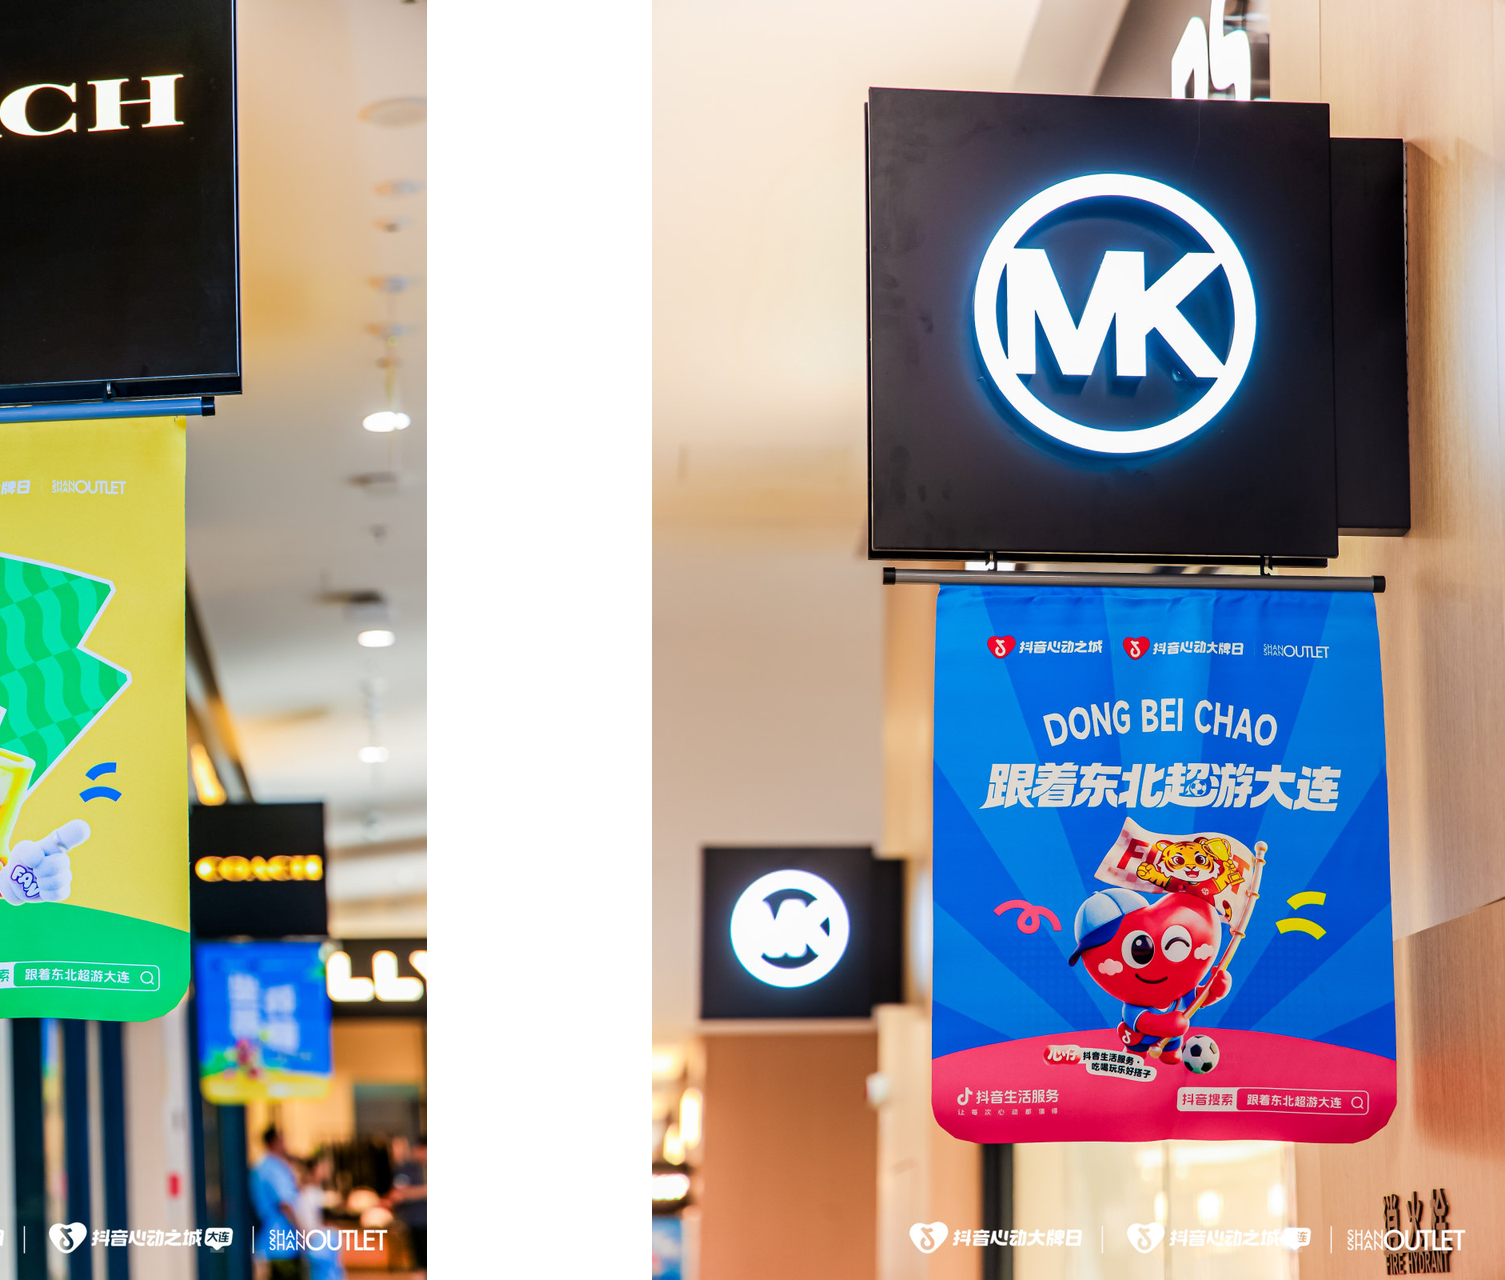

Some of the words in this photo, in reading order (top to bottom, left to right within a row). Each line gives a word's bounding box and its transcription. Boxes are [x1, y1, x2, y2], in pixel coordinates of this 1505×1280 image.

[1007, 248, 1226, 378] MK
[75, 480, 126, 495] OUTLET
[1019, 640, 1103, 654] 抖音心动之城
[1153, 641, 1244, 656] 抖音心动大牌日
[1284, 644, 1329, 659] OUTLET
[1043, 700, 1131, 746] DONG
[1141, 698, 1183, 732] BEI
[1195, 699, 1278, 746] CHAO
[979, 762, 1342, 811] 跟着东北超游大连
[25, 968, 130, 984] 跟着东北超游大连
[976, 1089, 1059, 1104] 抖音生活服务
[1182, 1093, 1234, 1106] 抖音搜索
[1246, 1094, 1342, 1109] 跟着东北超游大连
